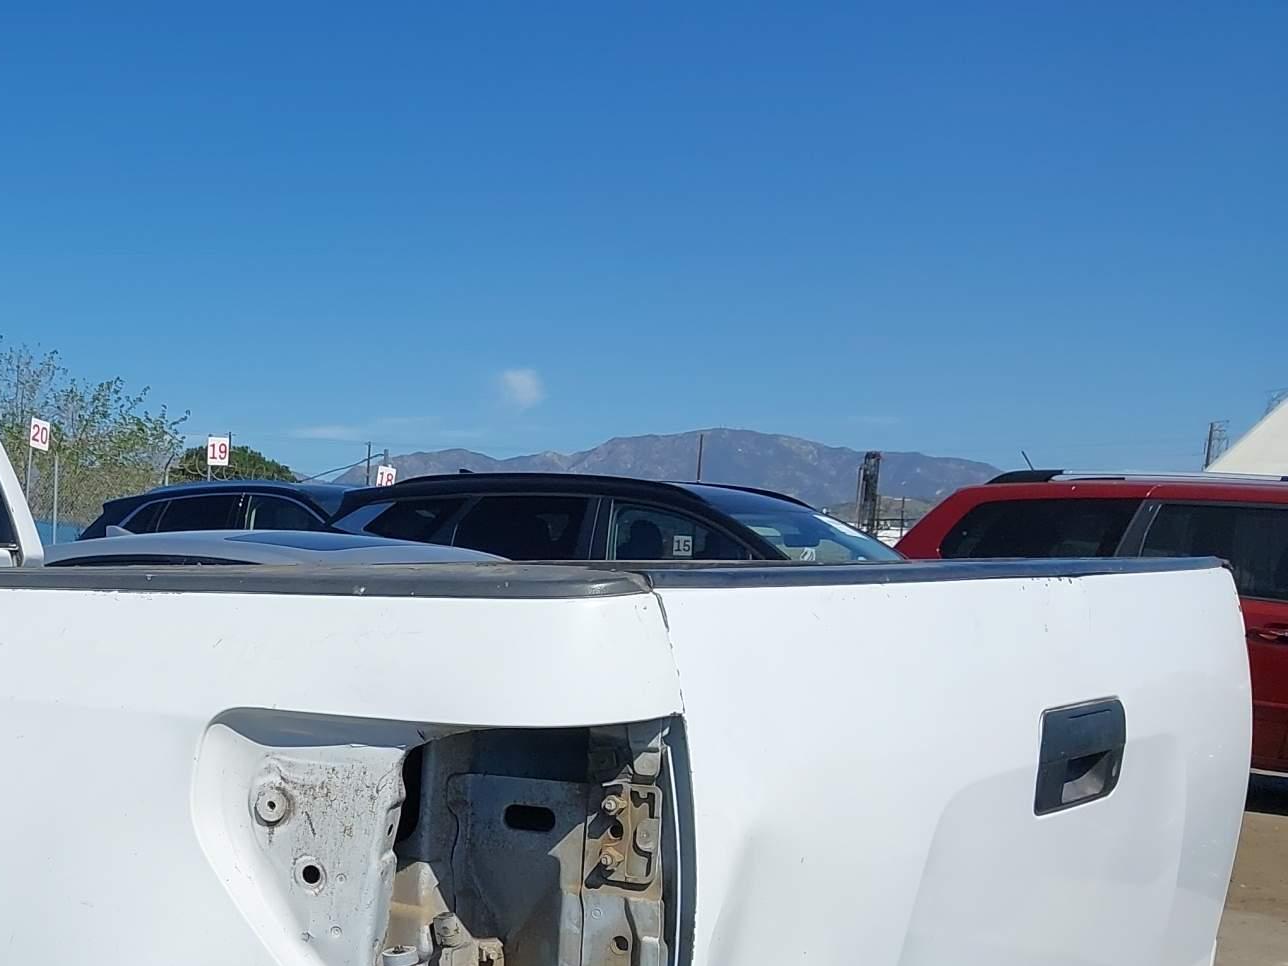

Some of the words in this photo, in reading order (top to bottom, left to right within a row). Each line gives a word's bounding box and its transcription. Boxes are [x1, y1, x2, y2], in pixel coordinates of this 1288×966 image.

[32, 424, 48, 445] 20
[209, 443, 227, 460] 19
[378, 472, 393, 486] 18
[674, 540, 691, 552] 15
